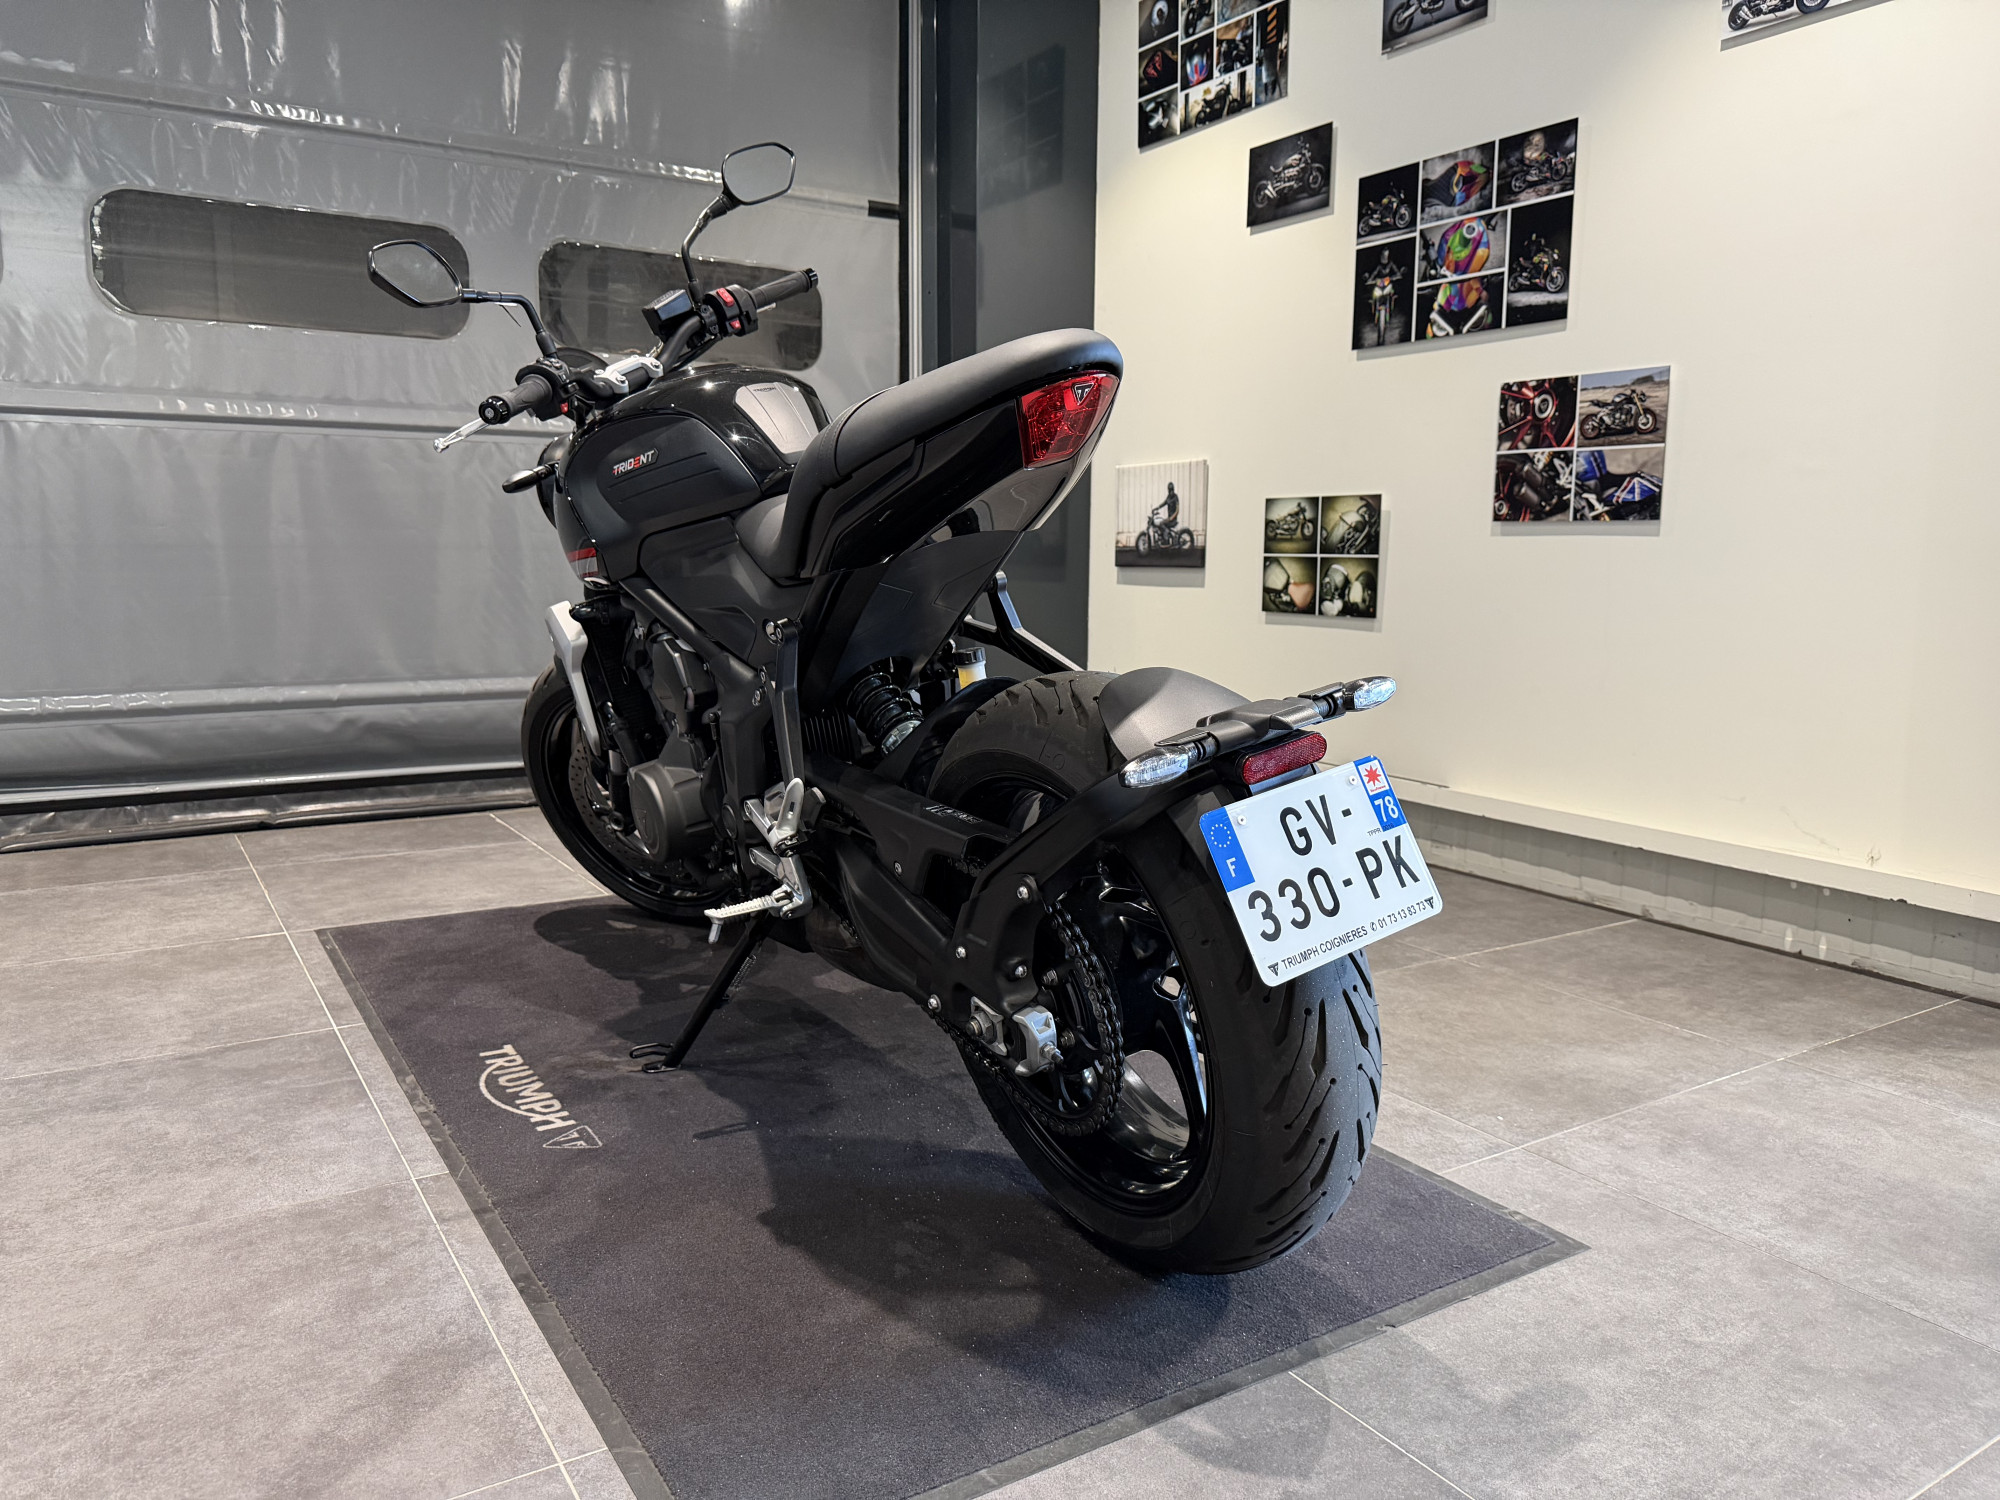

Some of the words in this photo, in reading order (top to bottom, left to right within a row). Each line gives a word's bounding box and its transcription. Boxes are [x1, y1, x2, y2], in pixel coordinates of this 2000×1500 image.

[612, 450, 655, 476] TRIDENT
[1374, 795, 1399, 822] 78
[1225, 857, 1237, 878] F
[1247, 834, 1421, 943] 330-PK
[1281, 945, 1320, 970] TRIUMPH
[1319, 925, 1368, 954] COIGNIERES
[1377, 917, 1388, 929] 01
[1387, 912, 1398, 924] 73
[1397, 908, 1407, 920] 13
[1406, 904, 1417, 916] 83
[1416, 900, 1426, 912] 73
[479, 1043, 577, 1132] TRIUMPH
